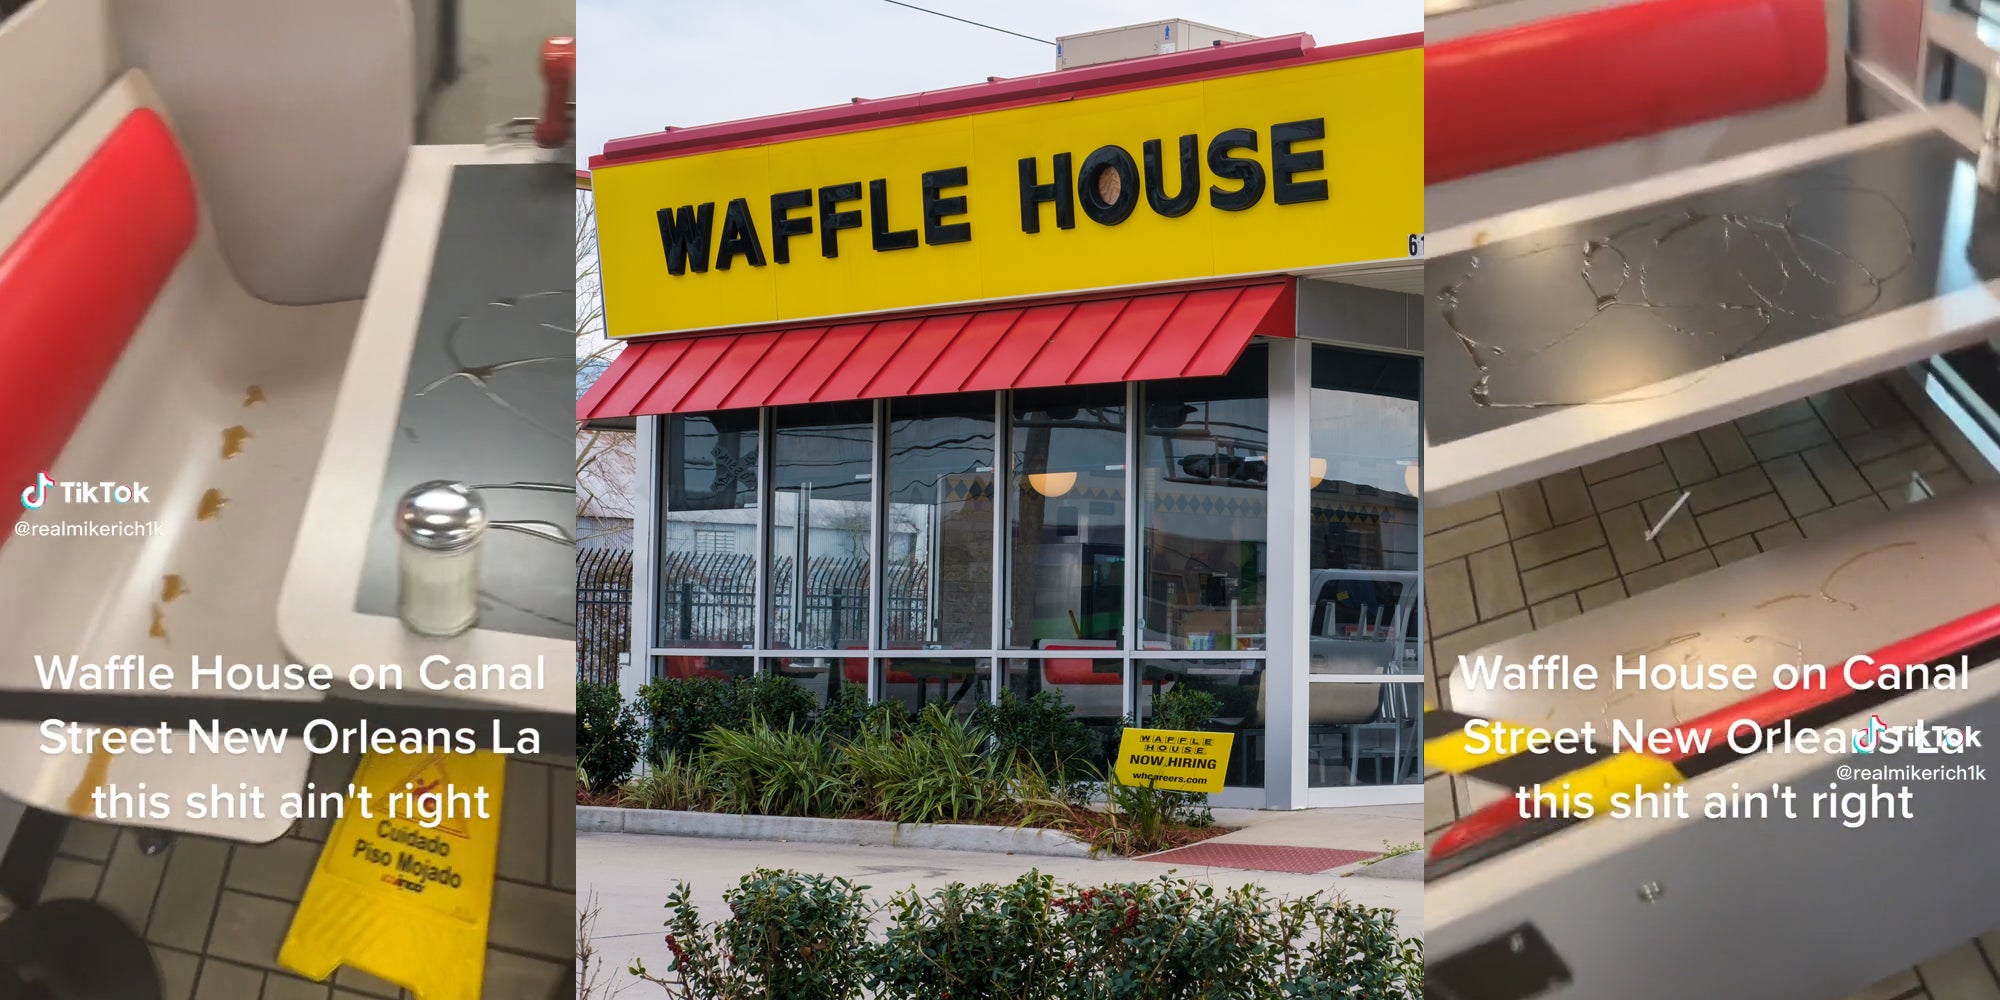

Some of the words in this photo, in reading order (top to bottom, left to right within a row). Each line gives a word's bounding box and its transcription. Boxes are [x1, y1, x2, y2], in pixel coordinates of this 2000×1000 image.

[656, 166, 972, 276] WAFFLE
[1018, 117, 1329, 234] HOUSE
[1408, 233, 1424, 256] 6
[1140, 735, 1214, 746] WAFFLE
[1144, 744, 1207, 755] HOUSE
[1129, 754, 1165, 766] NOW
[1167, 757, 1217, 770] HIRING
[1132, 771, 1208, 785] whcareers.com
[376, 819, 451, 857] Cuidado
[353, 838, 392, 867] Piso
[397, 851, 463, 889] Mojado
